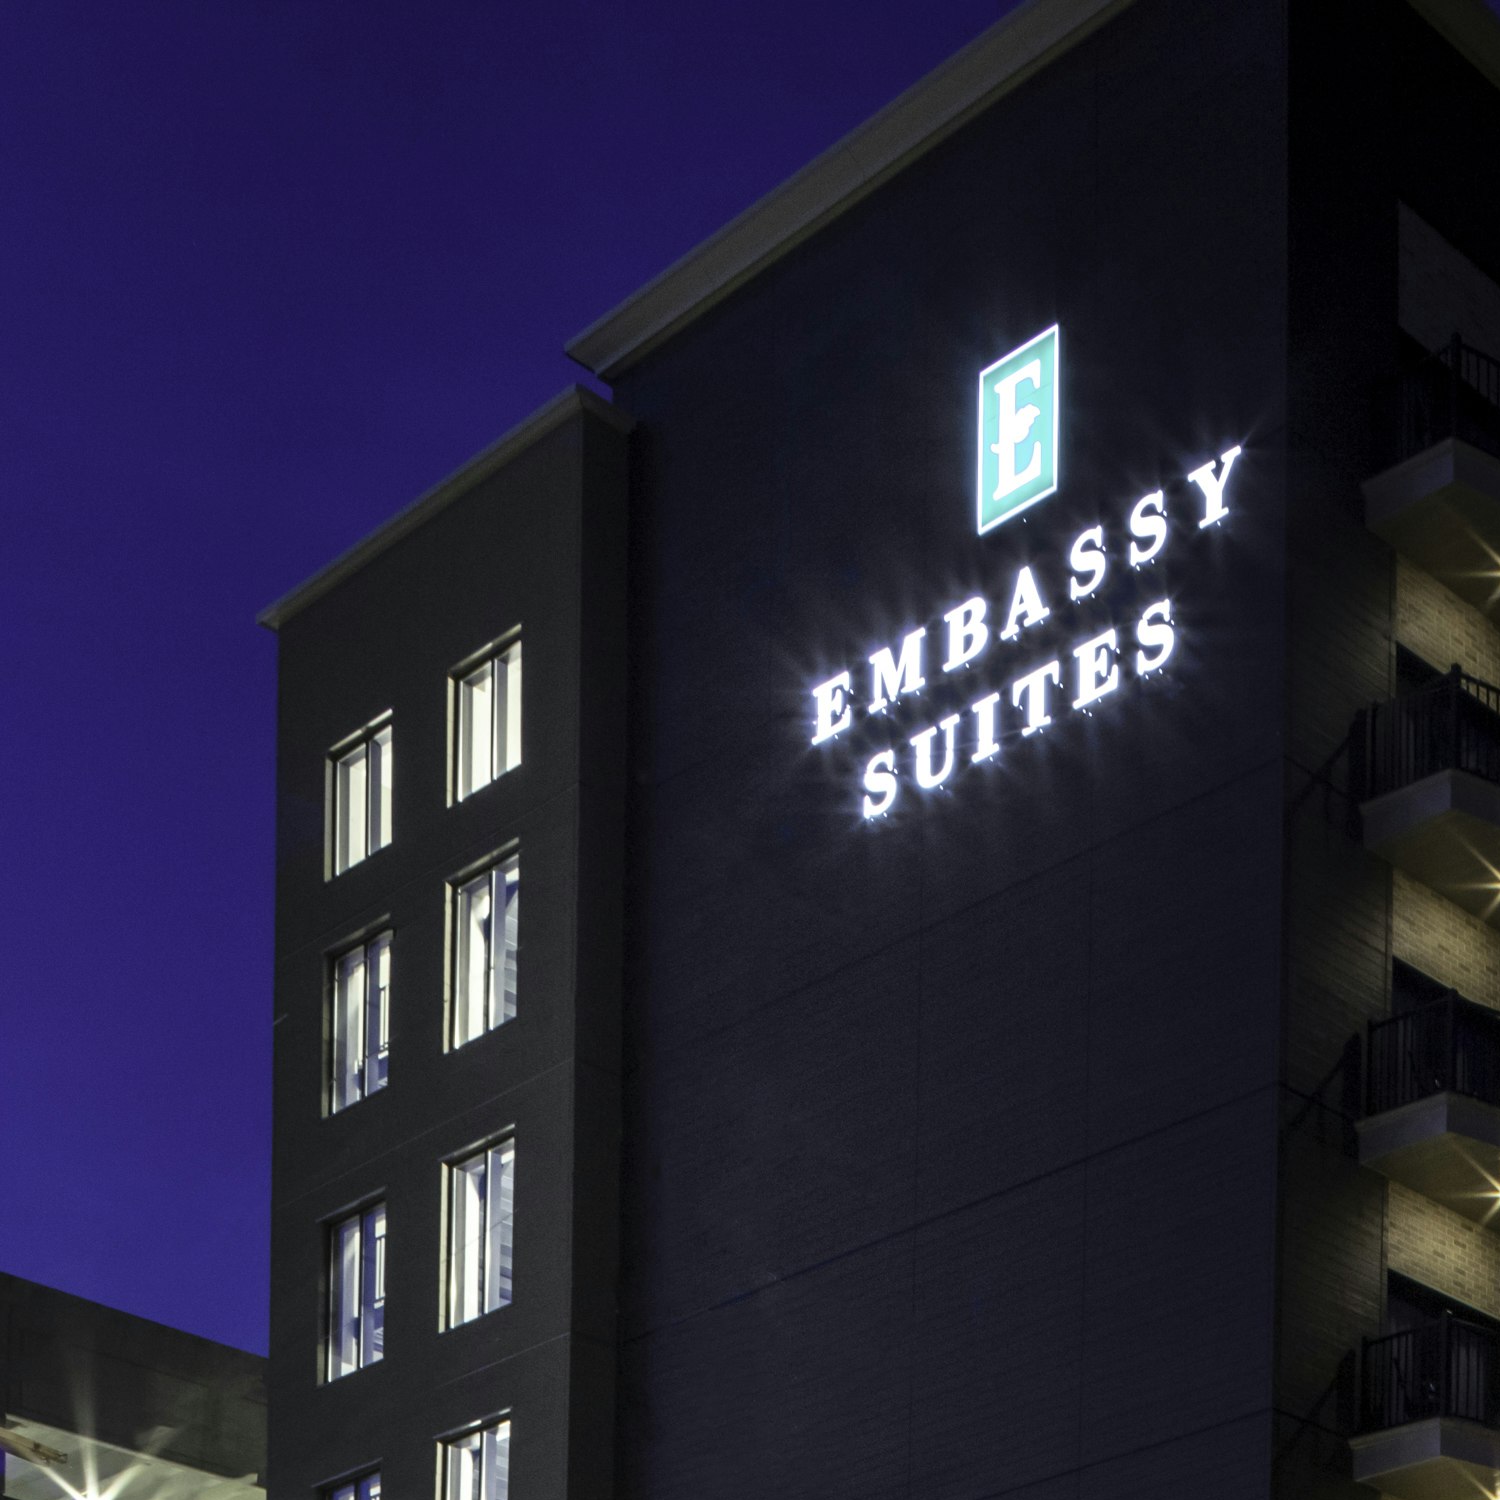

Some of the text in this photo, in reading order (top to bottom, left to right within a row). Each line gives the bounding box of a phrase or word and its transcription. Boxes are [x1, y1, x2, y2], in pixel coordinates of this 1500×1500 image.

[989, 358, 1041, 502] E
[811, 445, 1242, 746] EMBASSY
[863, 599, 1175, 819] SUITES
